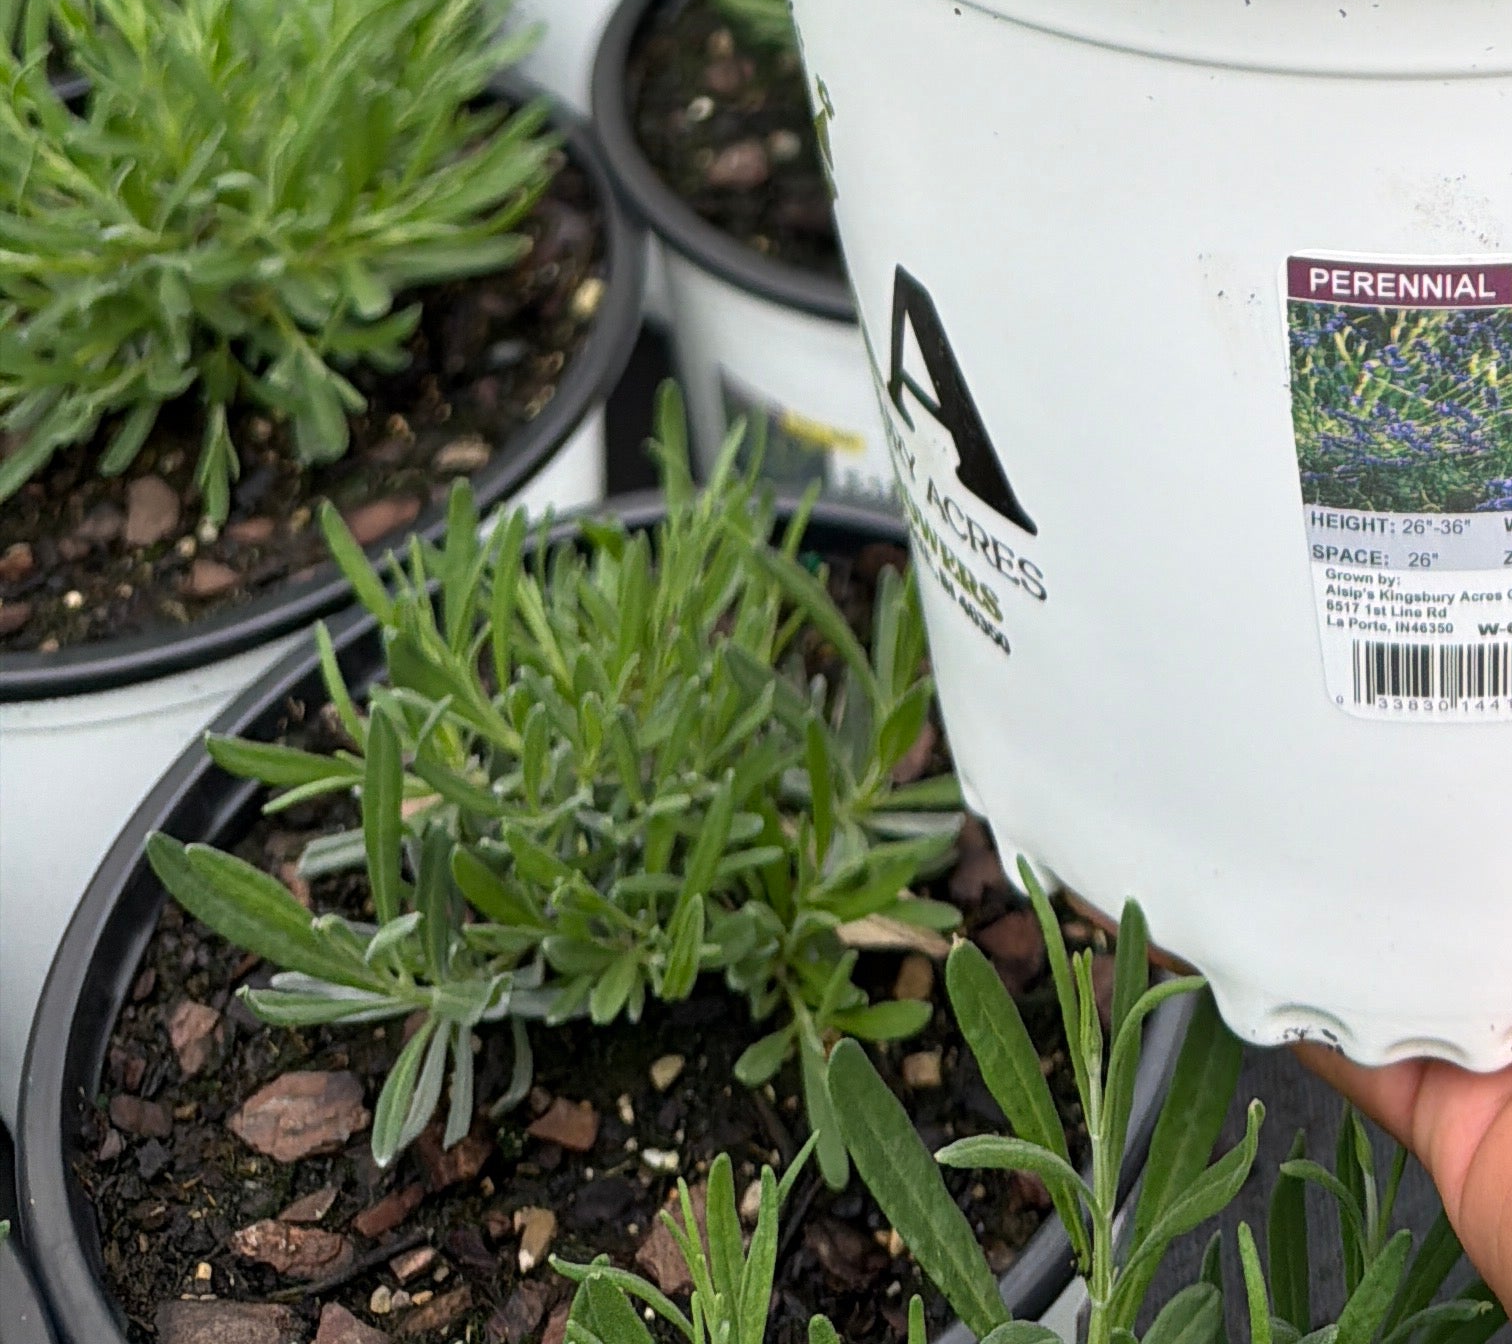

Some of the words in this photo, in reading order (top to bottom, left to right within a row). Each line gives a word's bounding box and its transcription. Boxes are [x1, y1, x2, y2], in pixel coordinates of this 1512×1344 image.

[1309, 267, 1496, 299] PERENNIAL
[1311, 510, 1395, 535] HEIGHT:
[1402, 517, 1471, 535] 26"-36"
[927, 476, 1047, 601] ACRES
[1312, 543, 1389, 566] SPACE:
[1408, 551, 1439, 568] 26"
[1325, 568, 1374, 584] Grown
[1378, 572, 1400, 587] by:
[1326, 584, 1375, 600] Alsip's
[1380, 589, 1455, 605] Kingsbury
[1460, 590, 1503, 602] Acres
[1426, 606, 1447, 618] Rd
